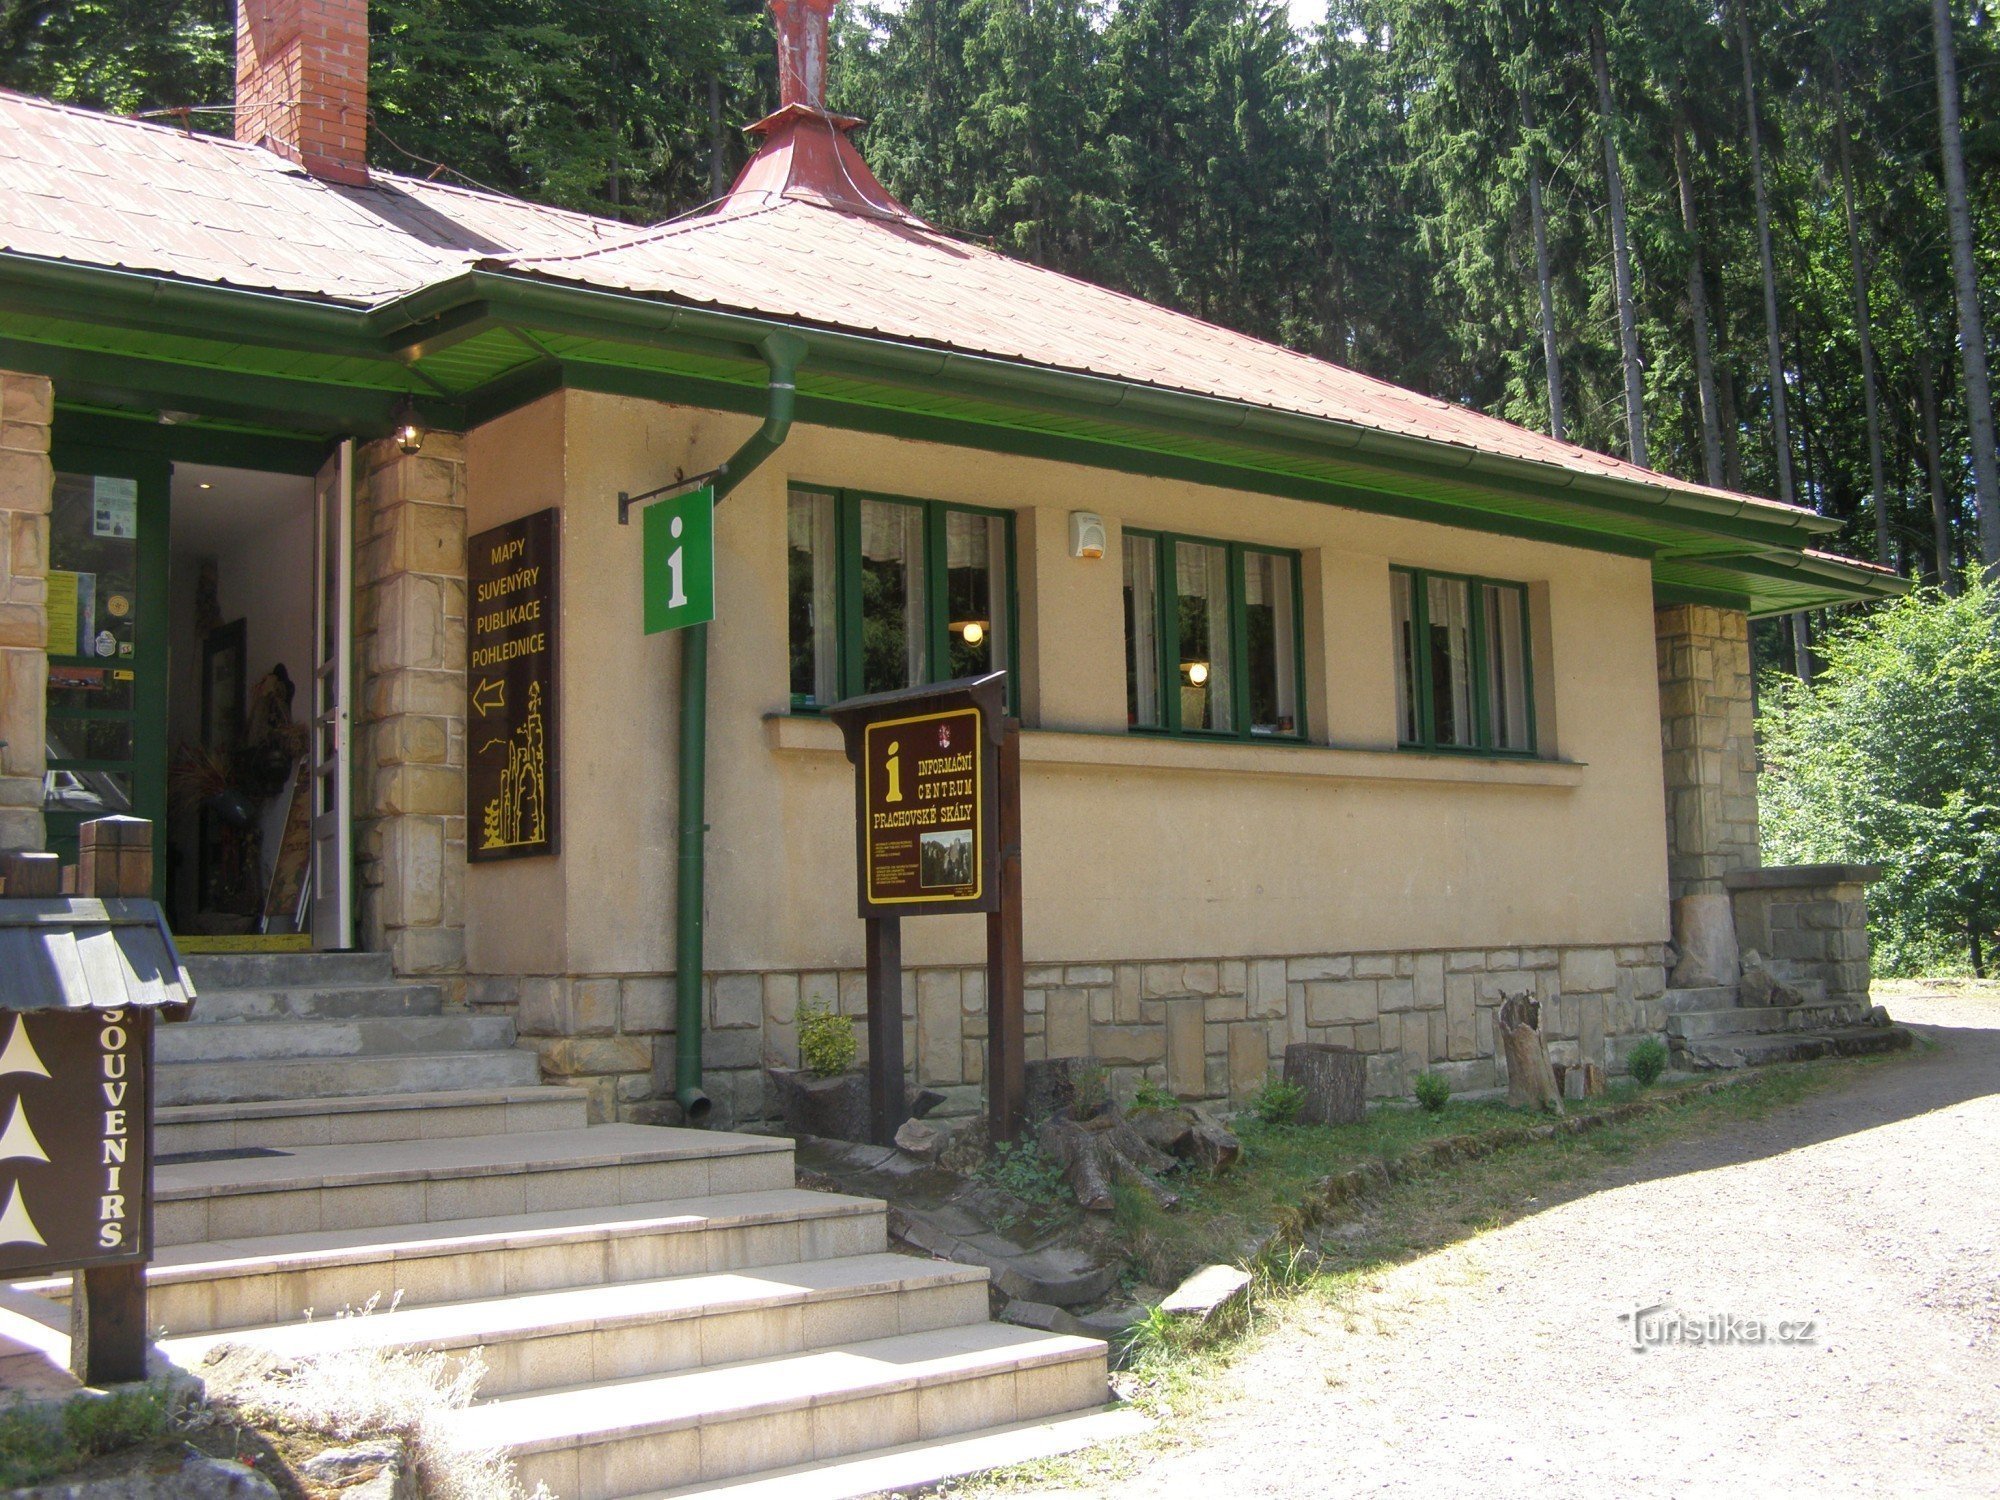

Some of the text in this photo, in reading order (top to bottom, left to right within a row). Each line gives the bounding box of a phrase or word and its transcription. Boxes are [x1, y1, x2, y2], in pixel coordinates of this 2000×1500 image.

[491, 538, 525, 566] MAPY
[478, 566, 540, 602] SUVENÝRY
[477, 600, 541, 635] PUBLIKACE
[472, 633, 545, 668] POHLEDNICE
[918, 751, 973, 776] INFORMAČNÍ
[918, 779, 973, 800] CENTRUM
[874, 802, 973, 829] PRACHOVSKÉ SKÁLY
